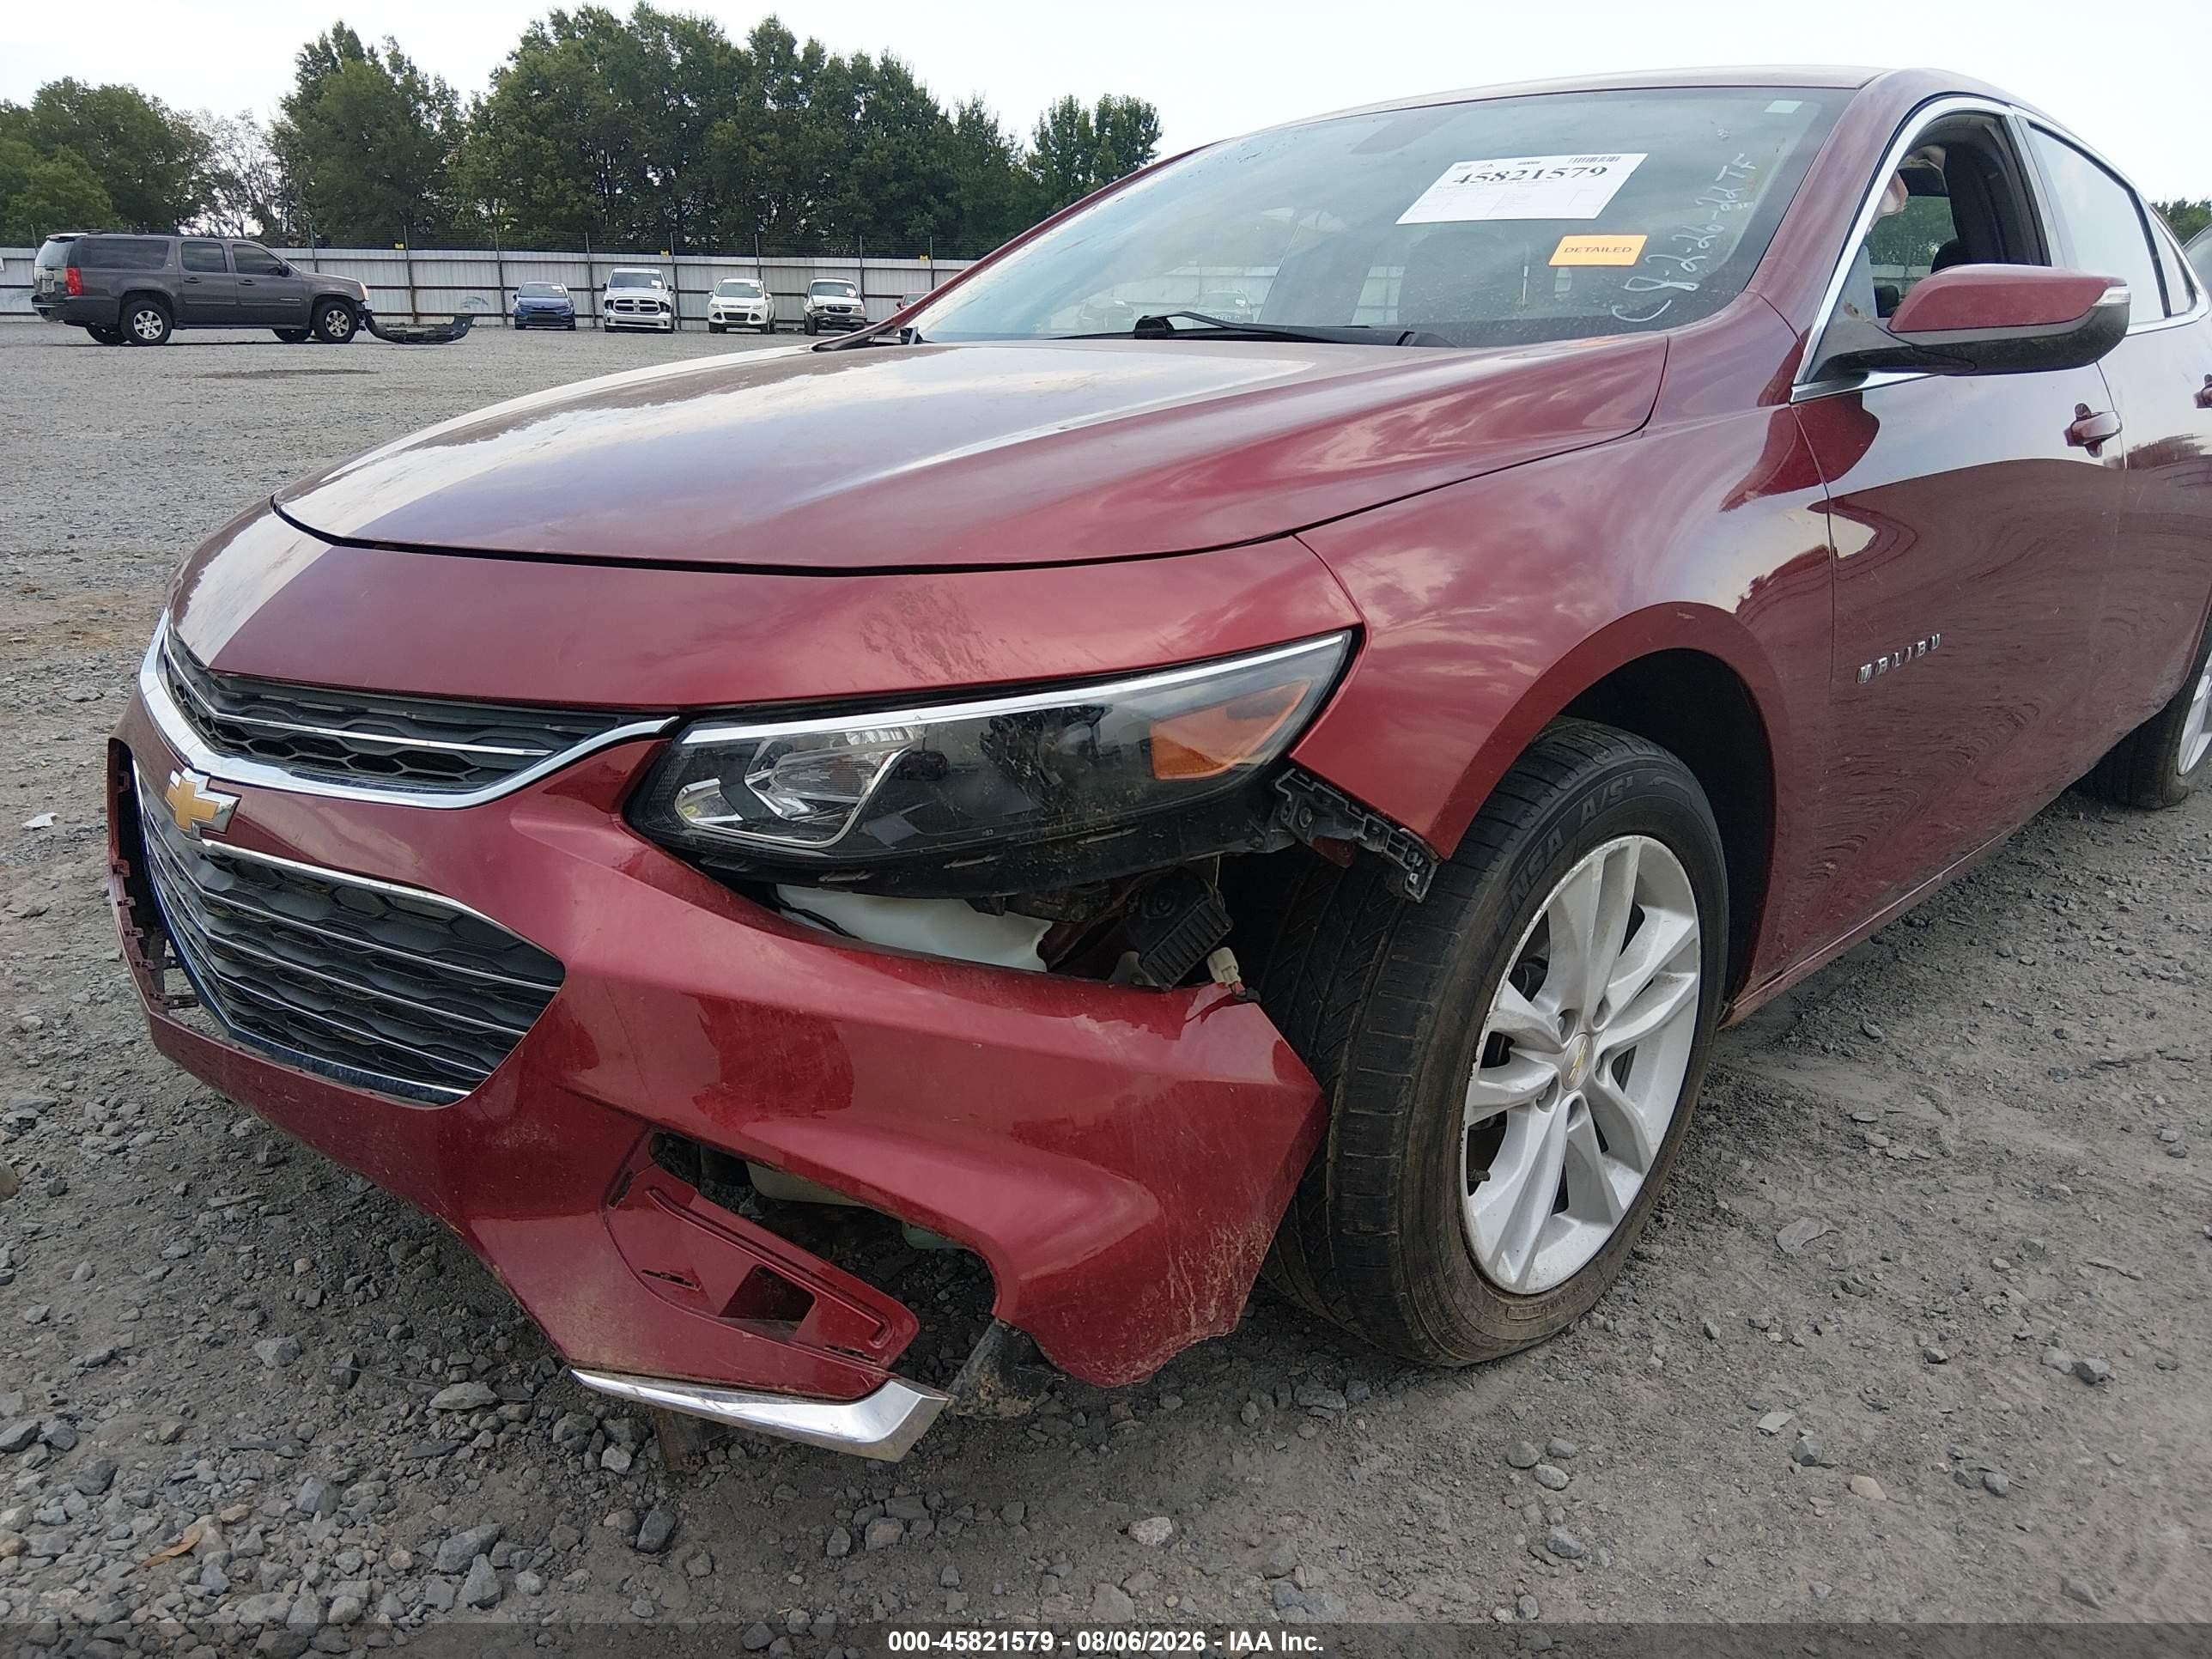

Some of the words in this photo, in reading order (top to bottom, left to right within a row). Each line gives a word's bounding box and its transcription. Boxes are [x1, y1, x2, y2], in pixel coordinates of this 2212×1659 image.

[1453, 165, 1608, 185] 45821579
[1563, 246, 1633, 254] DETAILED
[1856, 633, 1942, 684] MALIBU
